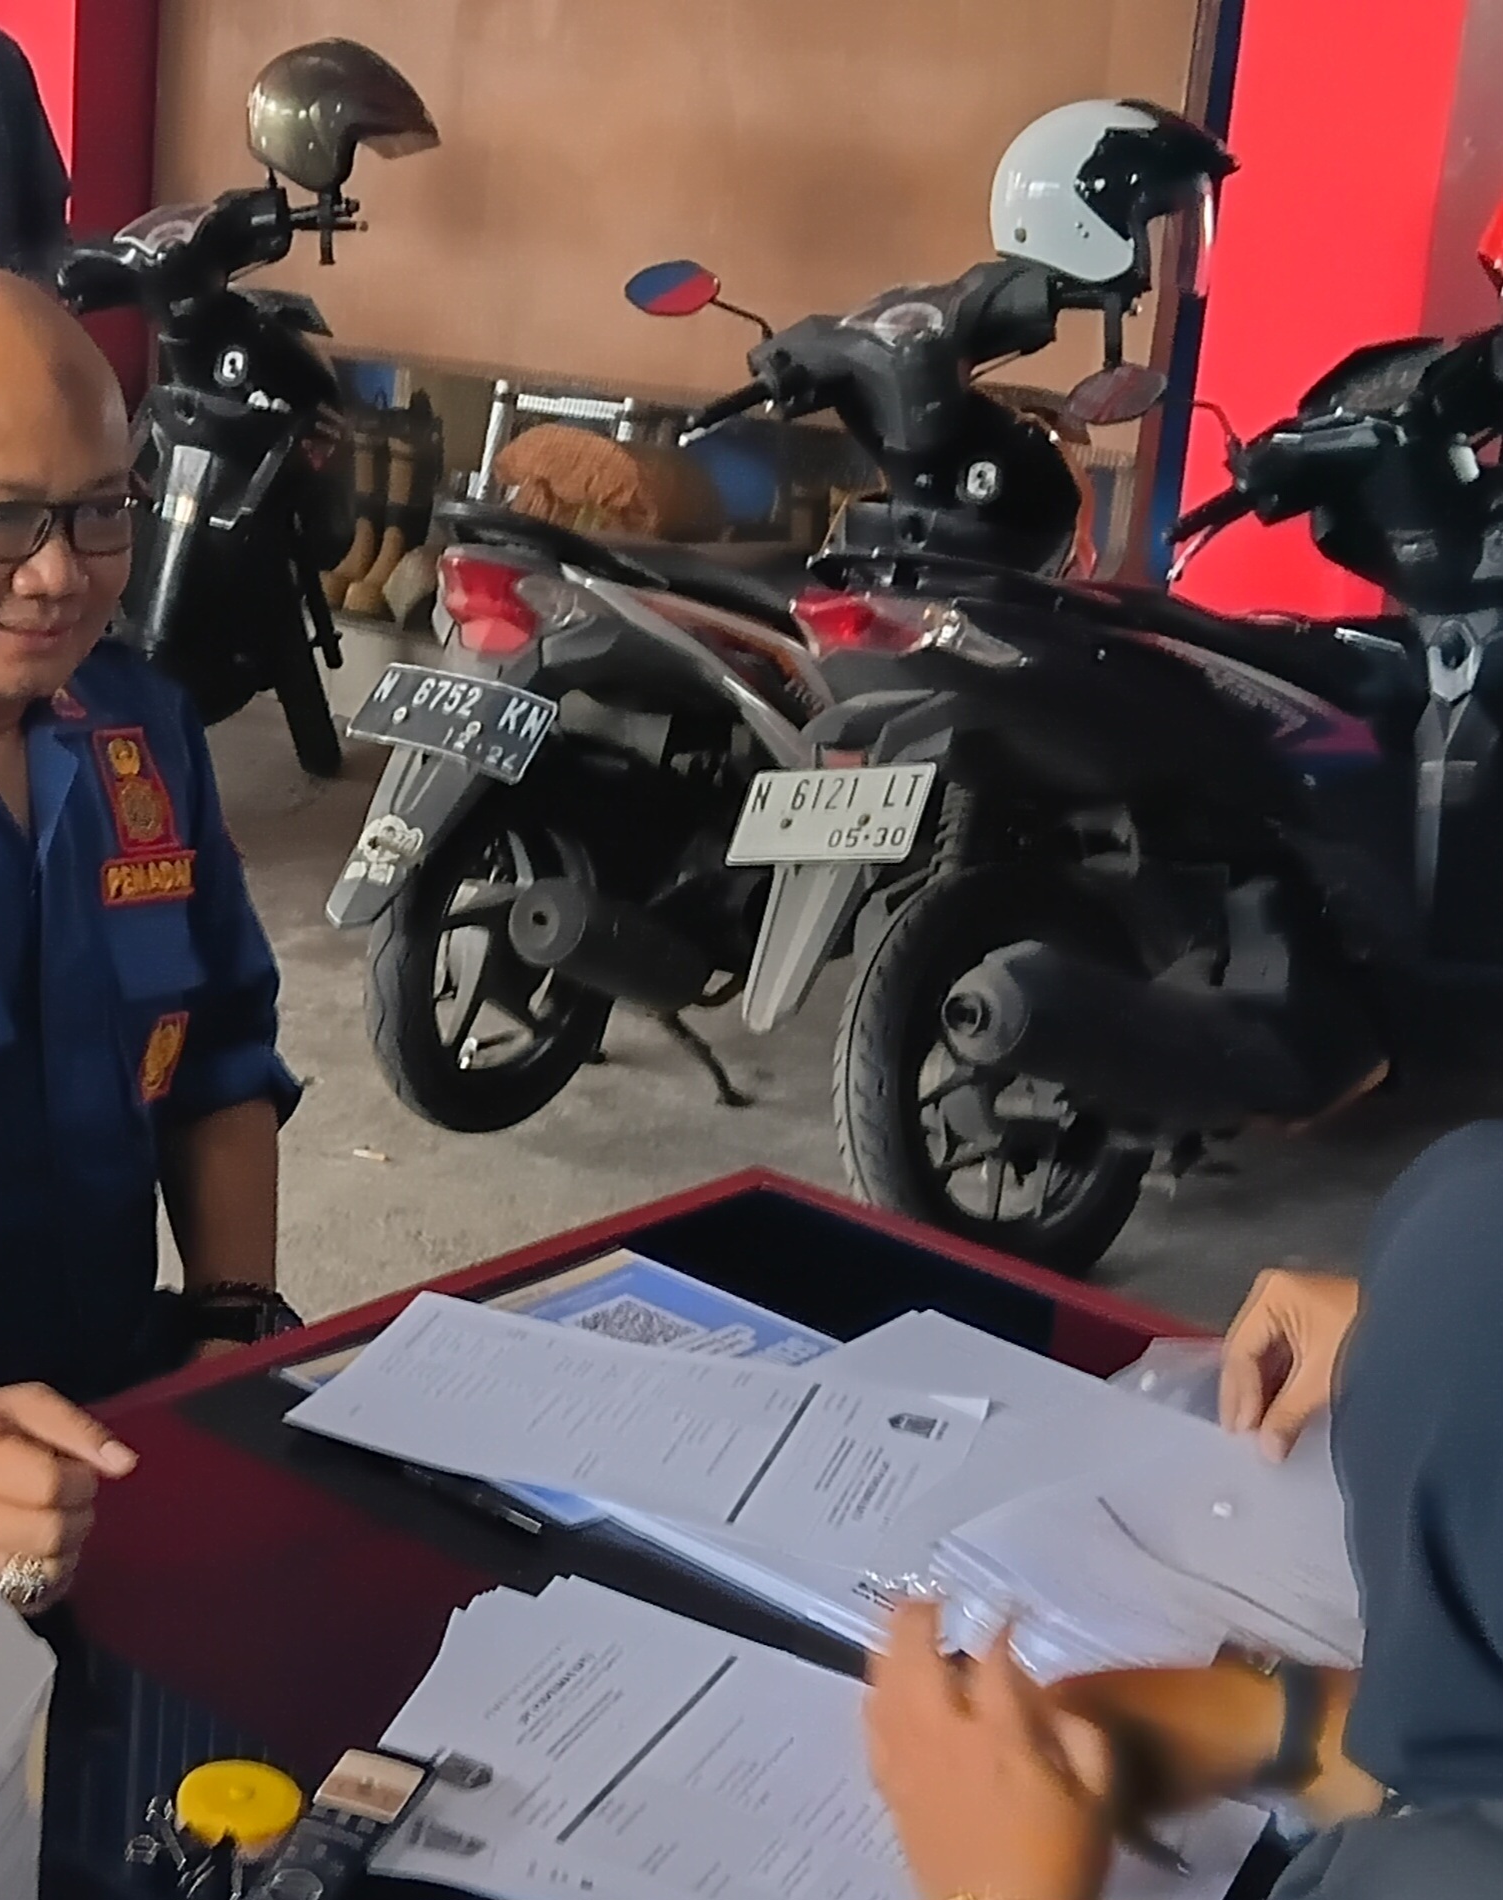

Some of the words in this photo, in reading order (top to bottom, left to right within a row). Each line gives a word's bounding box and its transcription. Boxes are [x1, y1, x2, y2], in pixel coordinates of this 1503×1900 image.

[373, 670, 401, 703] N
[412, 677, 483, 719] 6752
[497, 697, 549, 743] KN
[751, 780, 773, 813] N
[790, 776, 859, 811] 6121
[881, 773, 924, 809] LT
